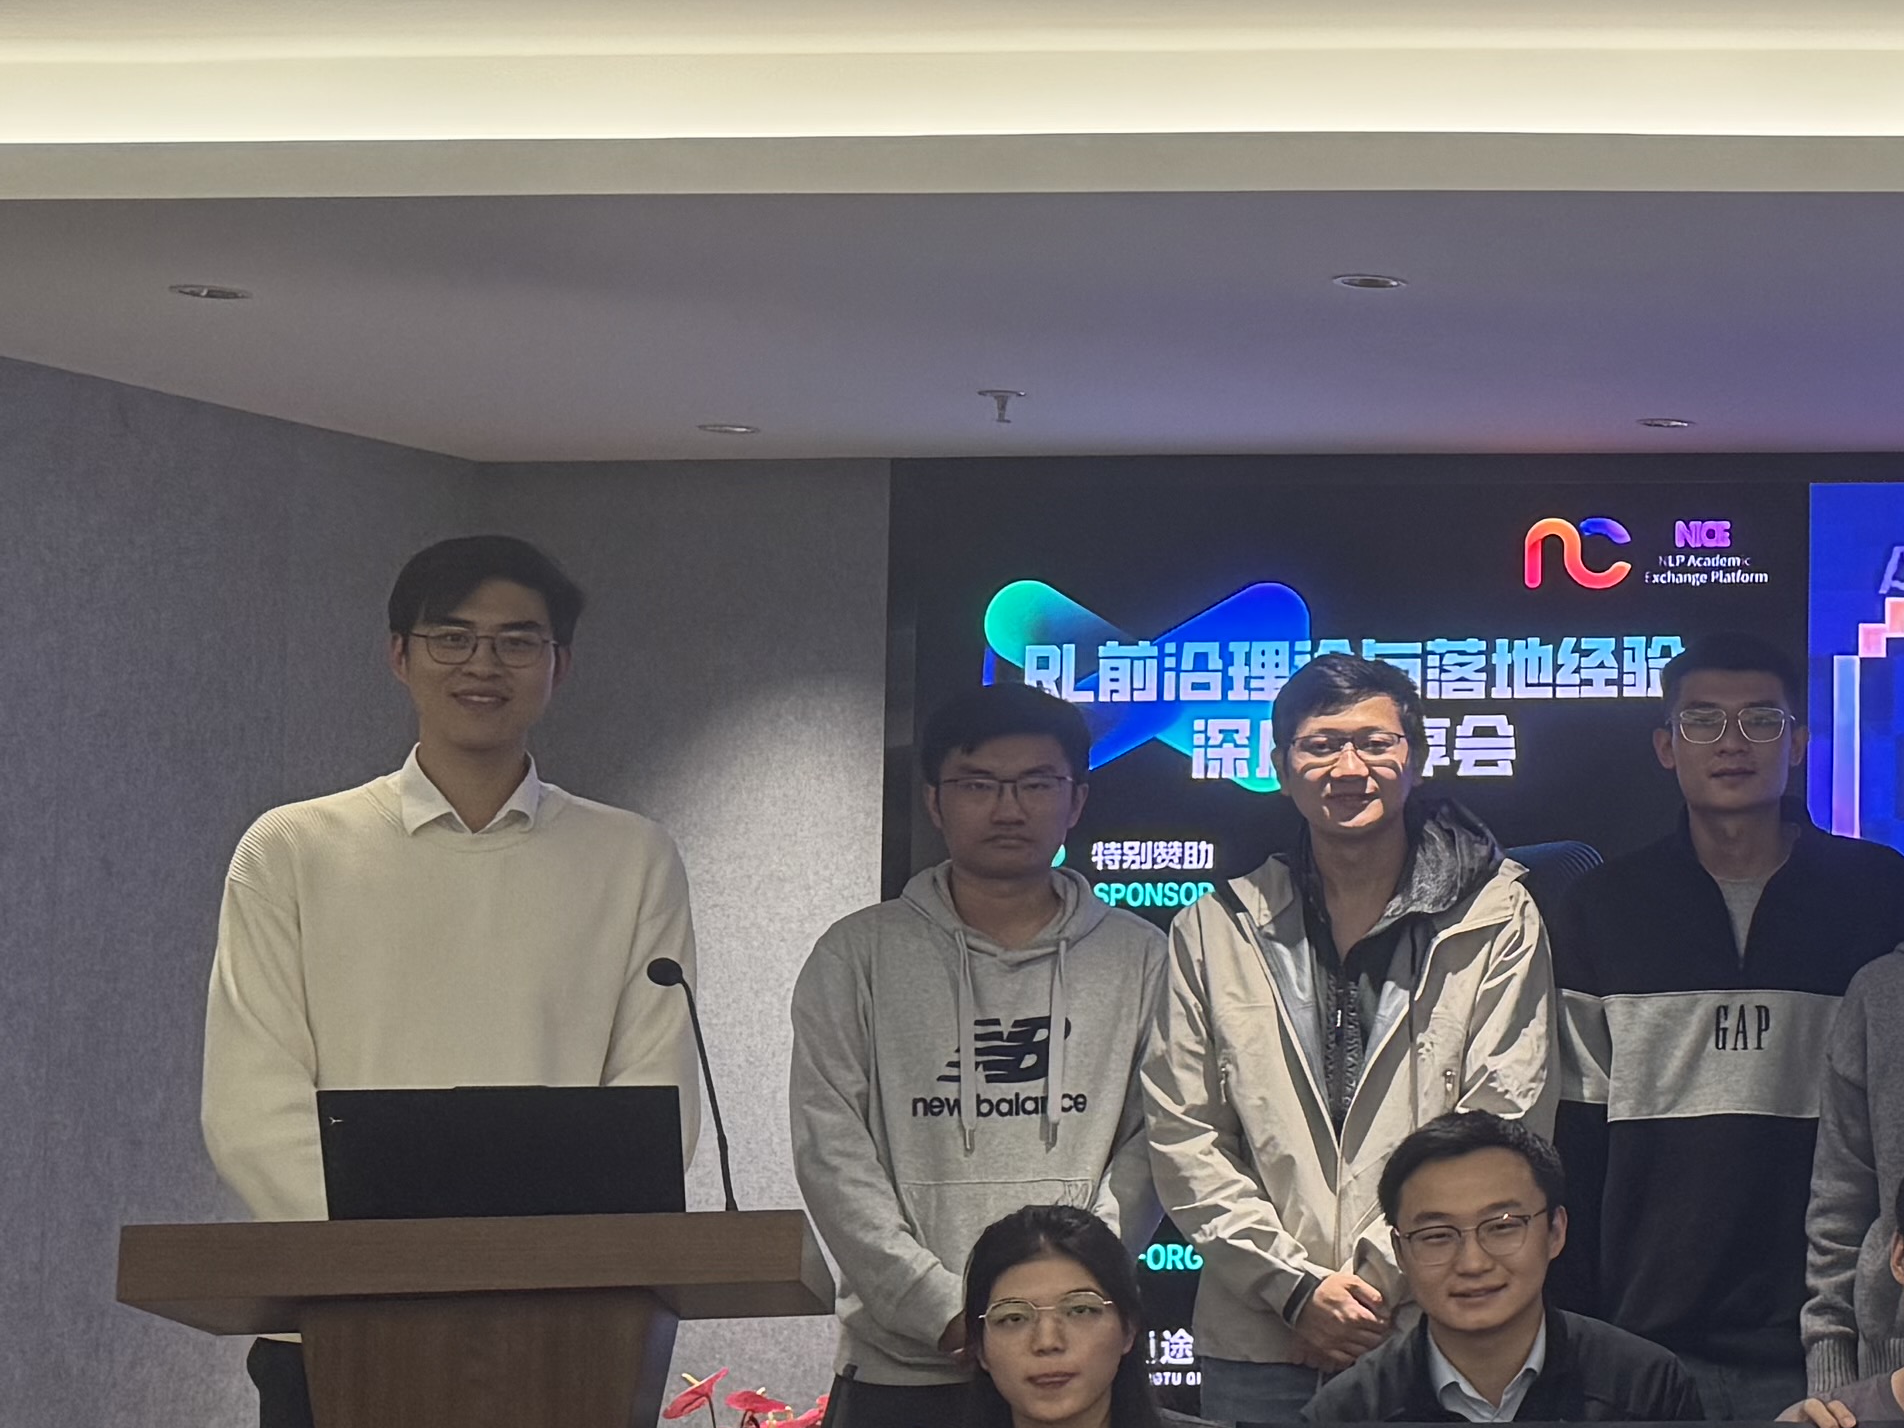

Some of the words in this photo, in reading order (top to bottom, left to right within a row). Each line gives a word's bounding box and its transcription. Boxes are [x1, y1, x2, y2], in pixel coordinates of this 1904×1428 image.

[1711, 569, 1768, 584] Platform
[1091, 840, 1214, 871] 特别赞助
[1714, 1004, 1771, 1051] GAP
